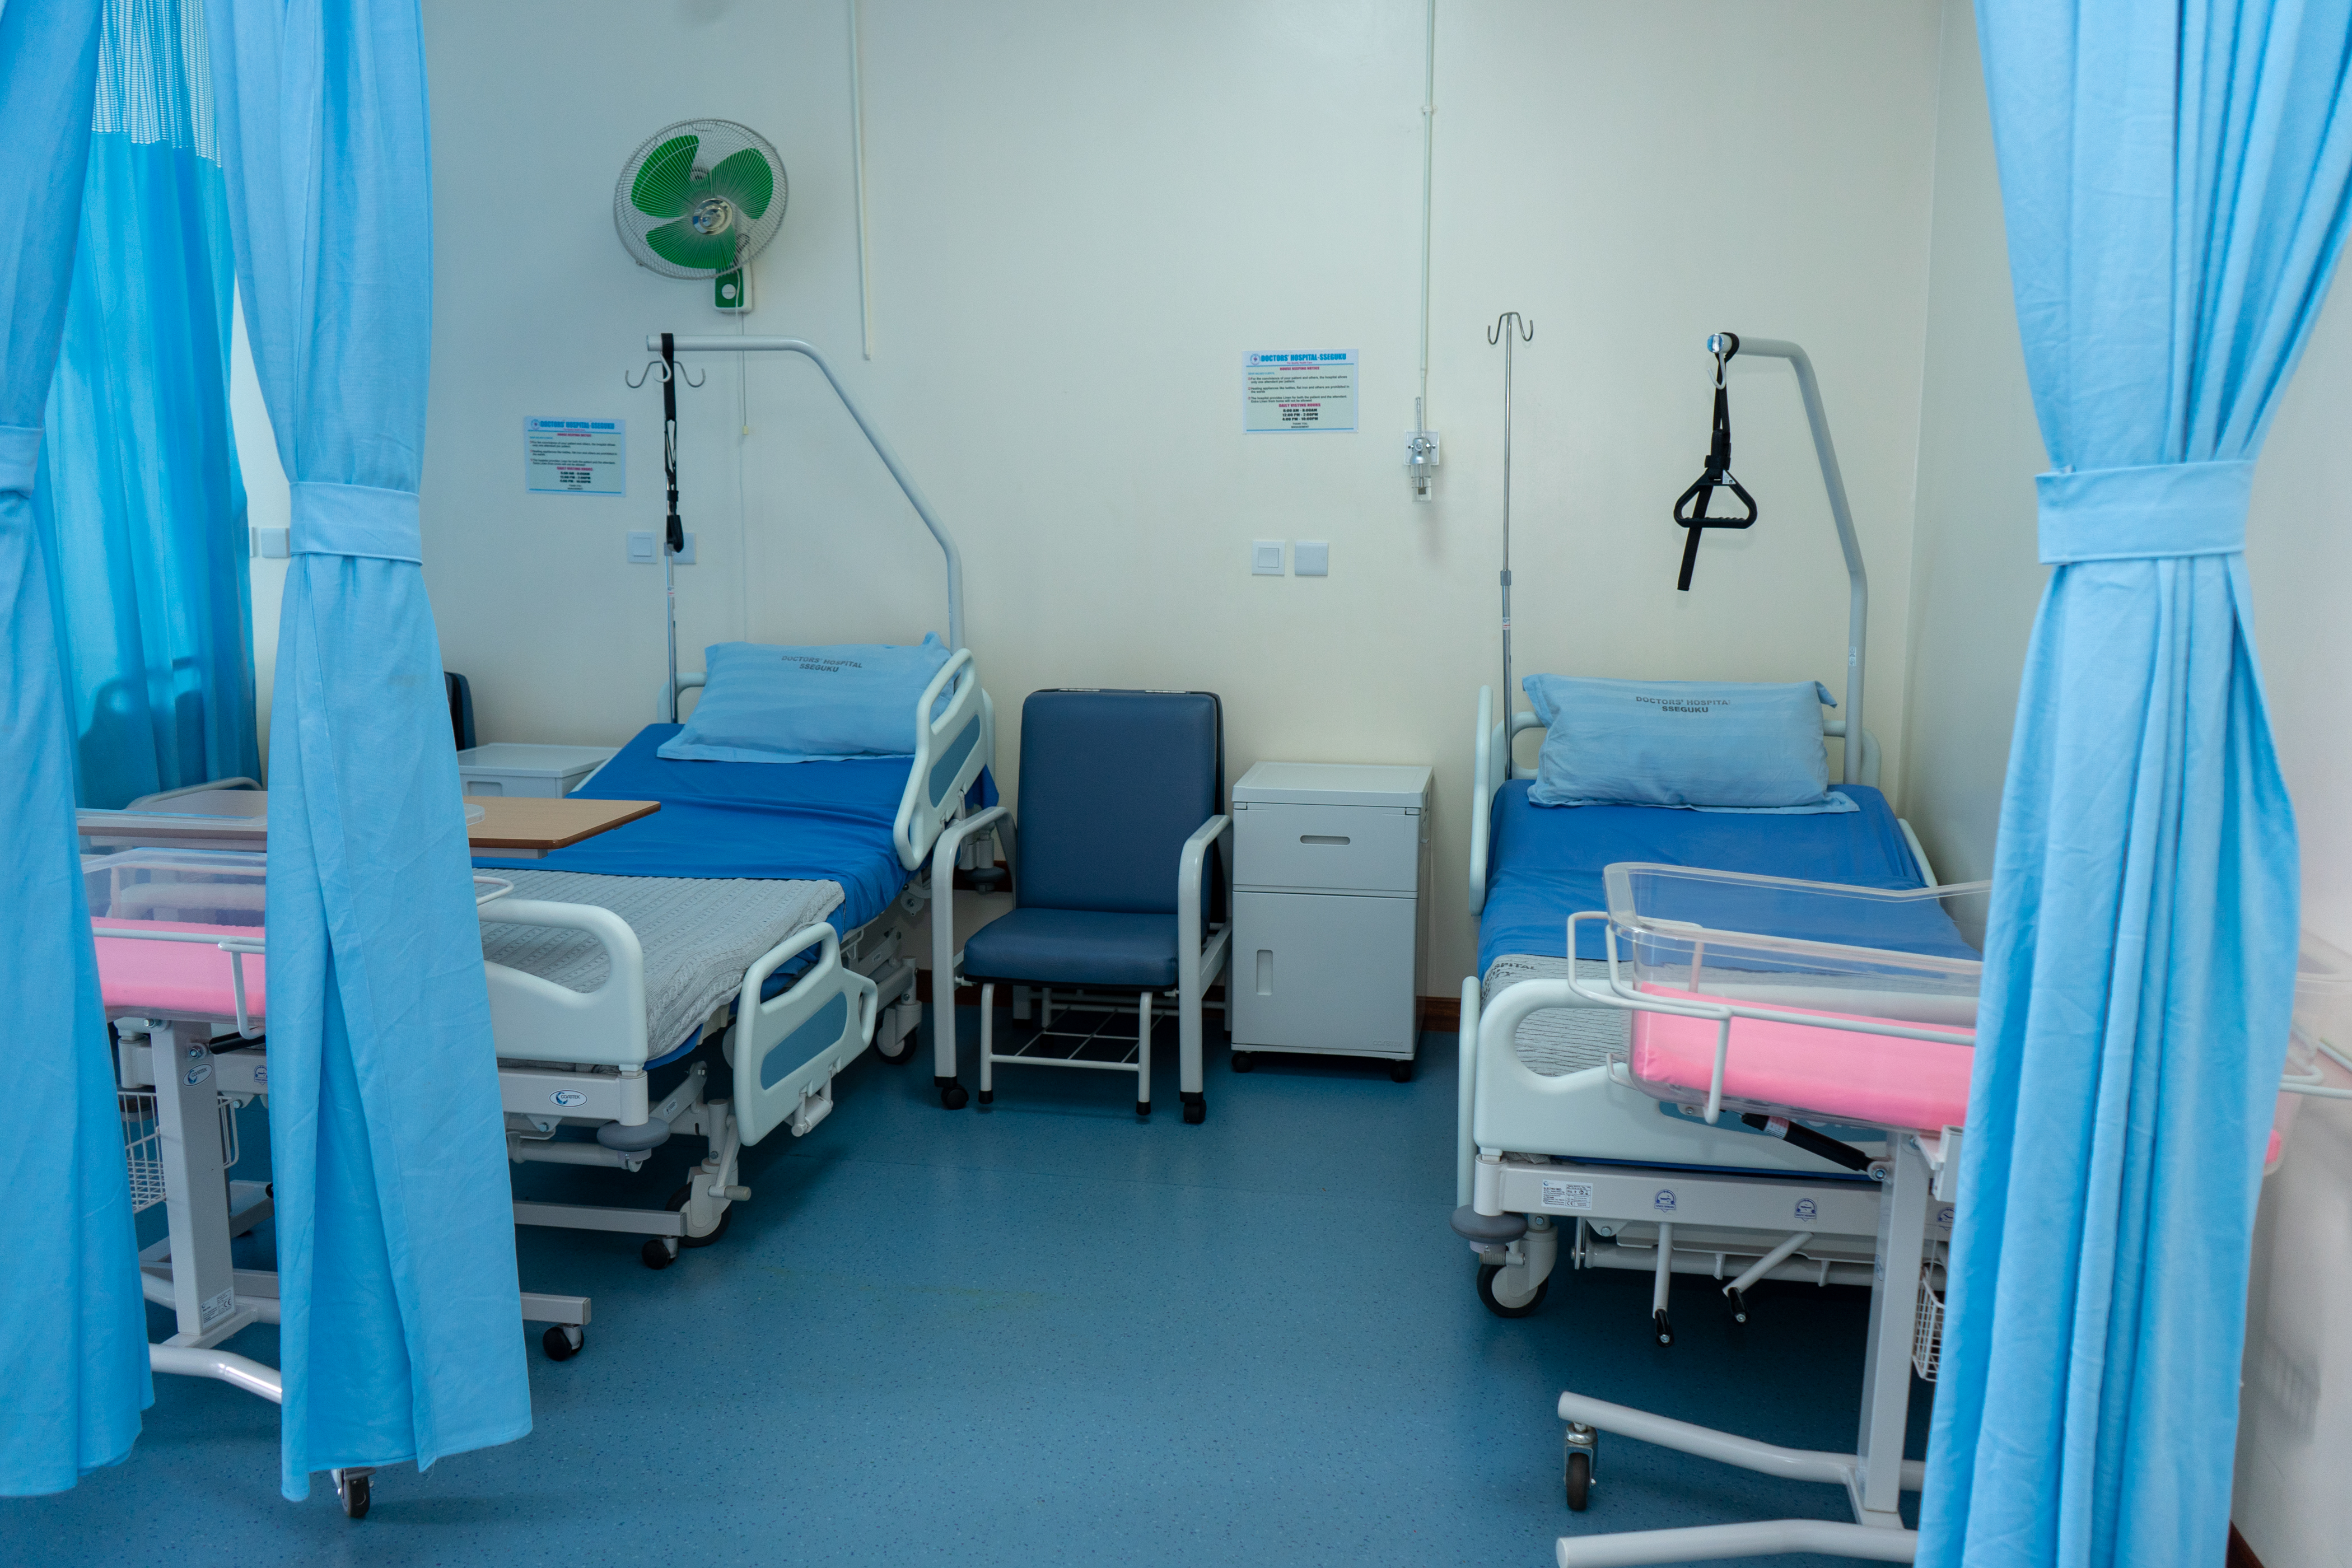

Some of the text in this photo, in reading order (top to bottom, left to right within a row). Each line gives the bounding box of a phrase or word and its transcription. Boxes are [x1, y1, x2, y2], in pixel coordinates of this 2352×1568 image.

[799, 664, 839, 672] SSEGUKU
[823, 659, 863, 668] HOSPITAL
[1636, 696, 1683, 705] DOCTORS'
